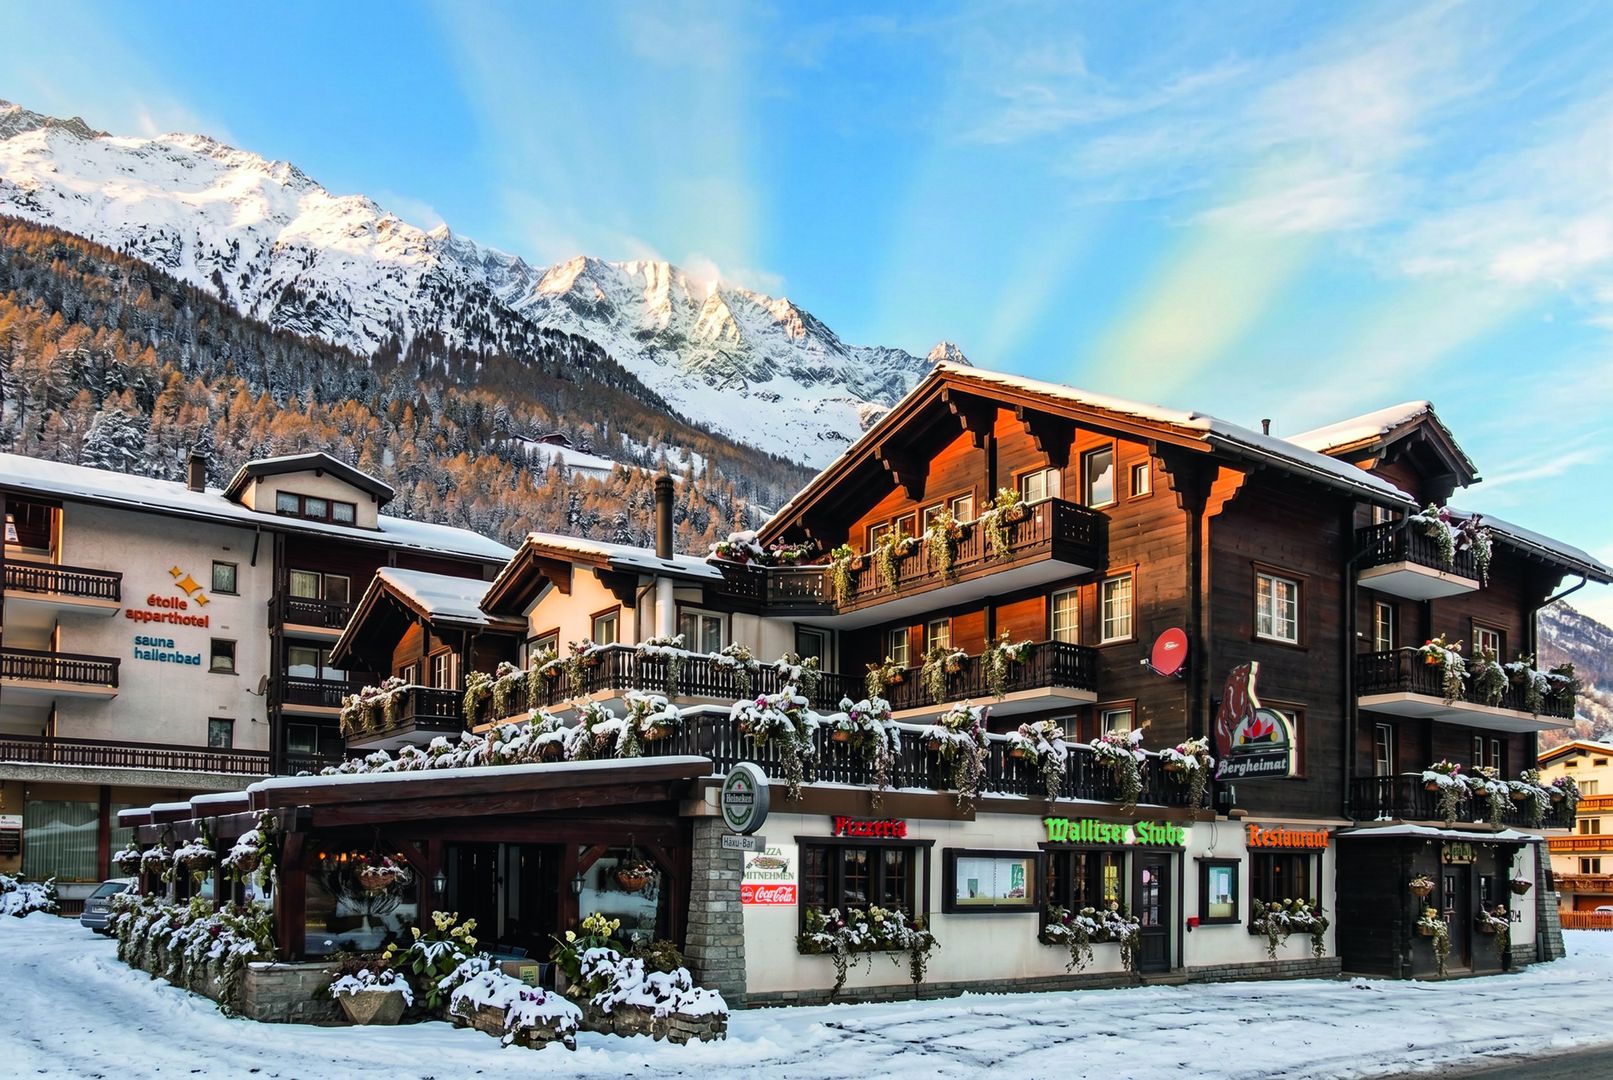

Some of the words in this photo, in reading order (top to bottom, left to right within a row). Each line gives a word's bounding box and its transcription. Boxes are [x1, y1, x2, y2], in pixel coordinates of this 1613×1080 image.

[125, 609, 209, 628] apparthotel
[134, 635, 175, 649] sauna
[134, 647, 201, 666] hallenbad
[1215, 757, 1287, 780] Bergheimat
[834, 816, 907, 838] Pizzeria
[1044, 817, 1129, 844] Walliser
[1134, 820, 1185, 845] Stube
[1247, 823, 1329, 848] Restaurant
[723, 836, 754, 848] Häxu-Bar
[755, 886, 794, 903] Coca-Cola
